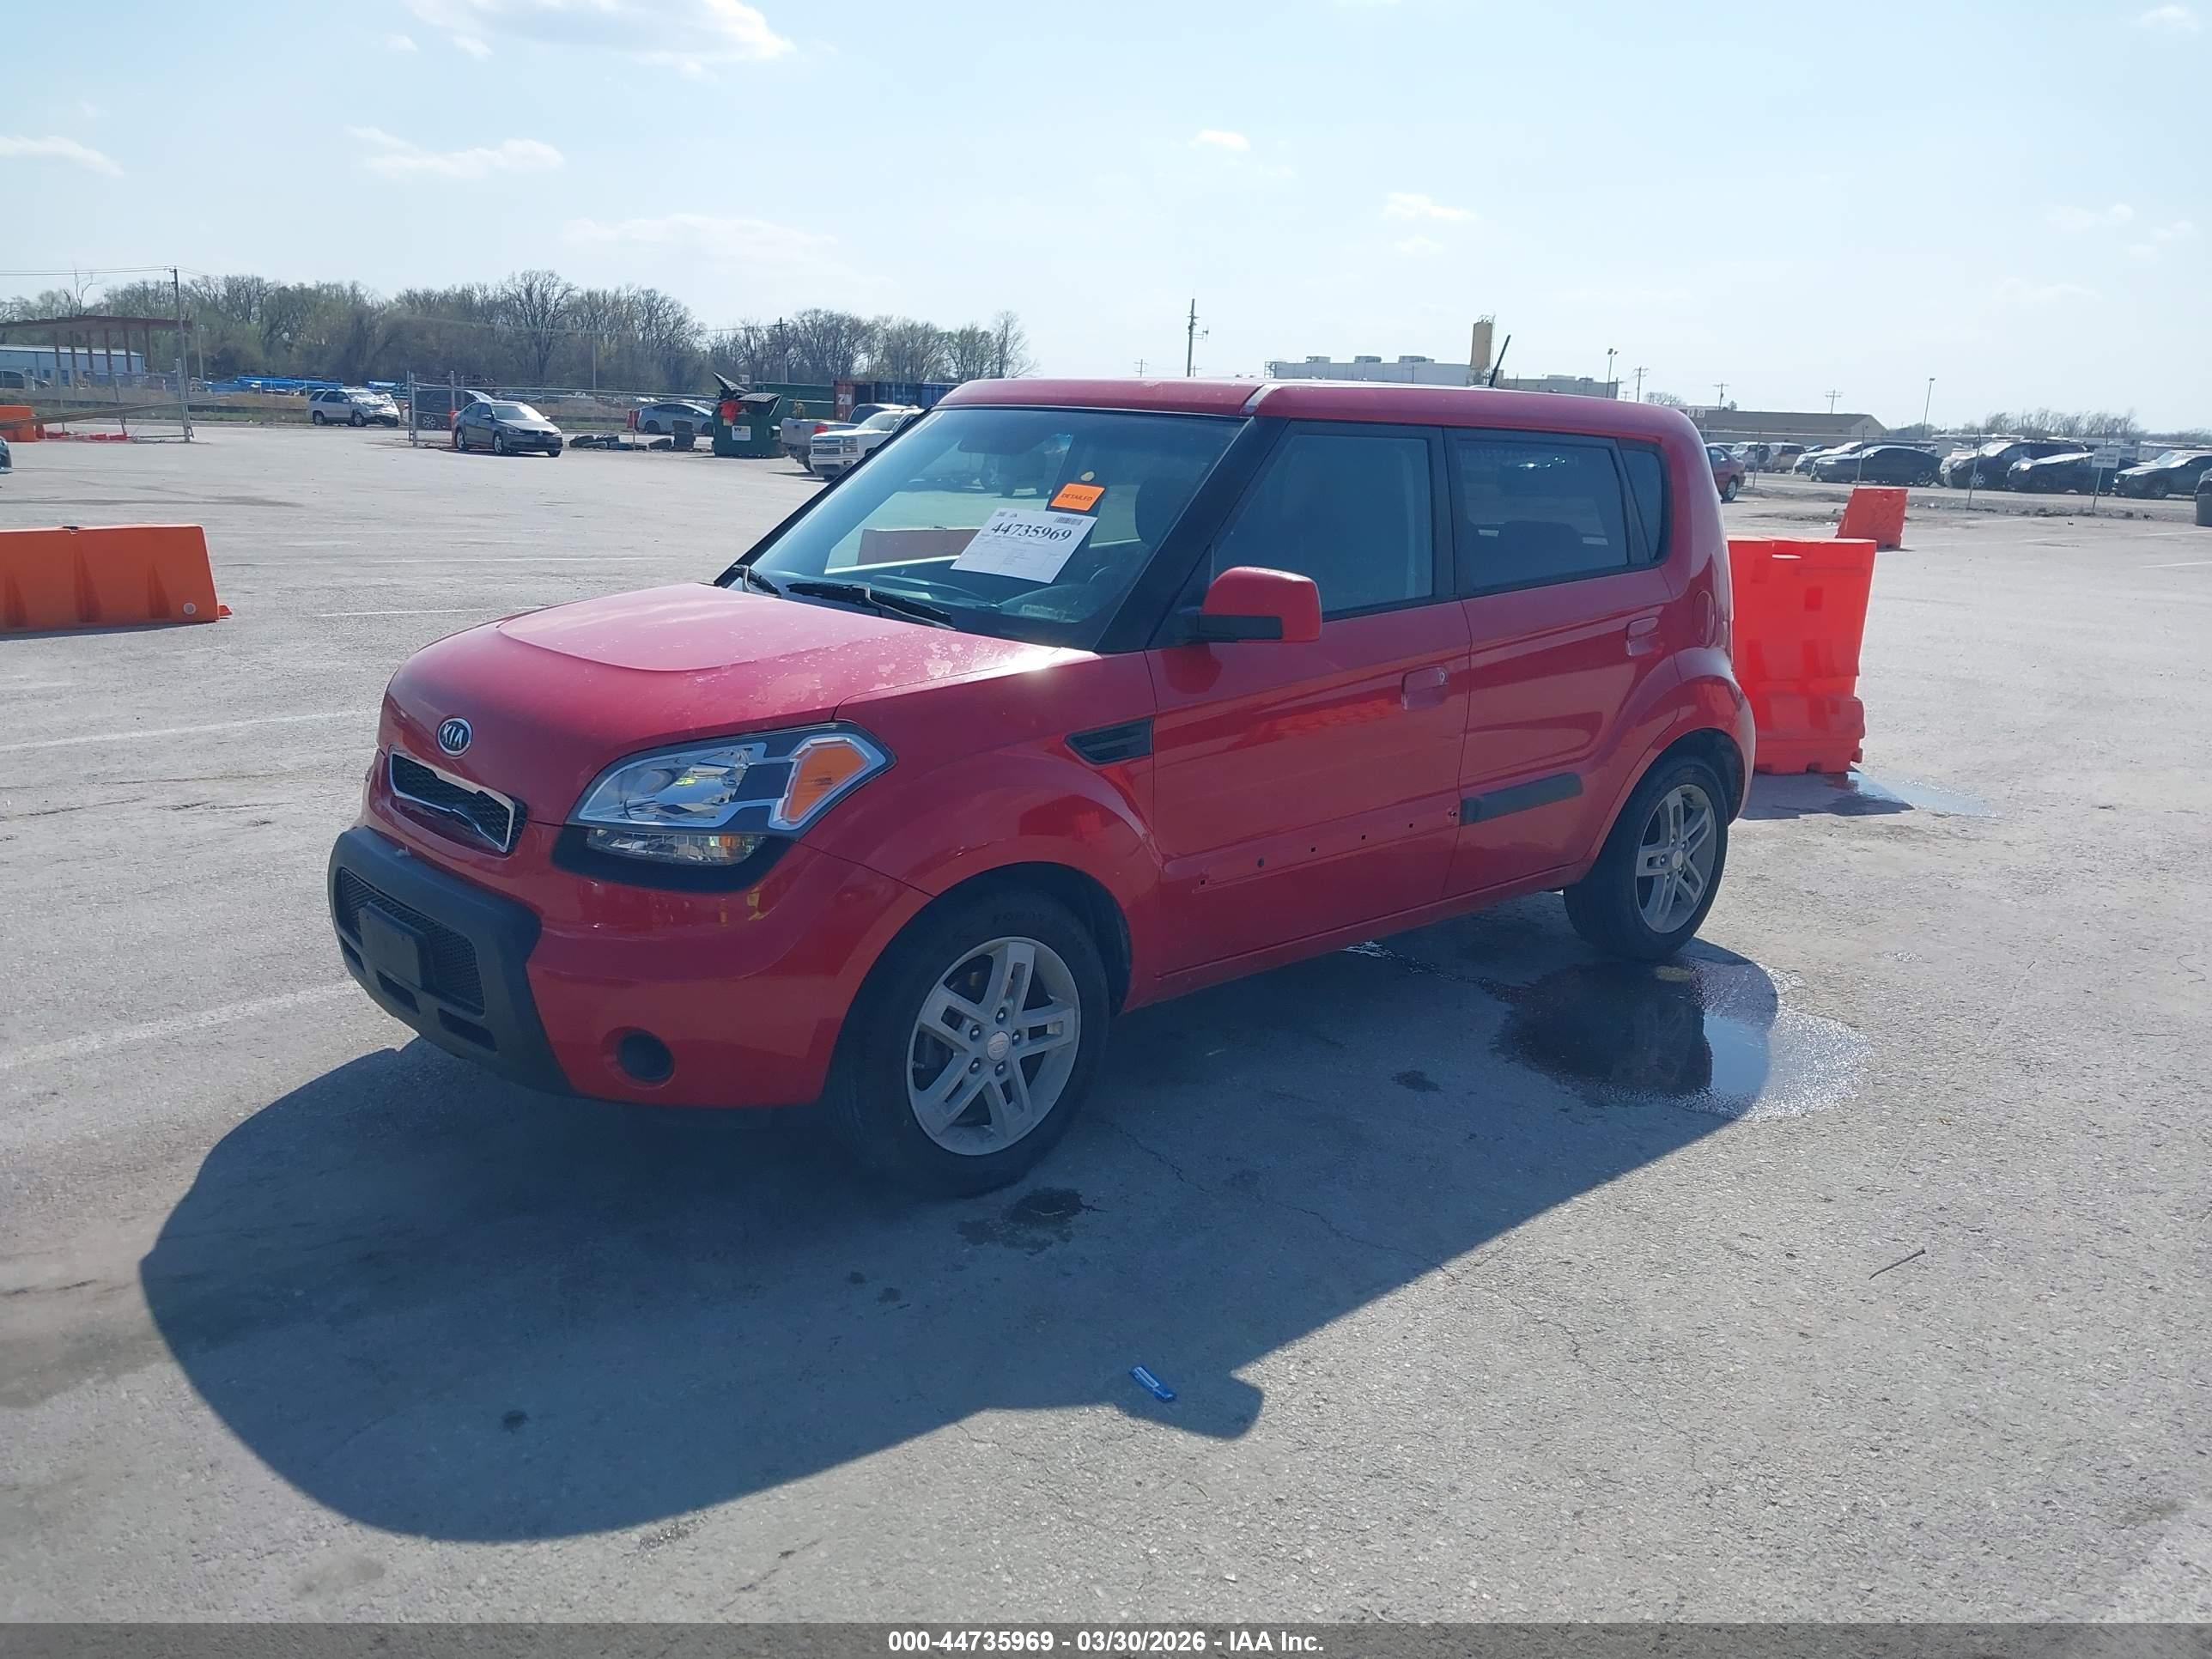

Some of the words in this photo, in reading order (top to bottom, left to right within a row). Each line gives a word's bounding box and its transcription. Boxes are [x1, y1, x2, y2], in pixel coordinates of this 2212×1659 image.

[1060, 493, 1093, 501] DETAILED
[991, 521, 1073, 542] 44735969
[442, 723, 465, 749] KIA
